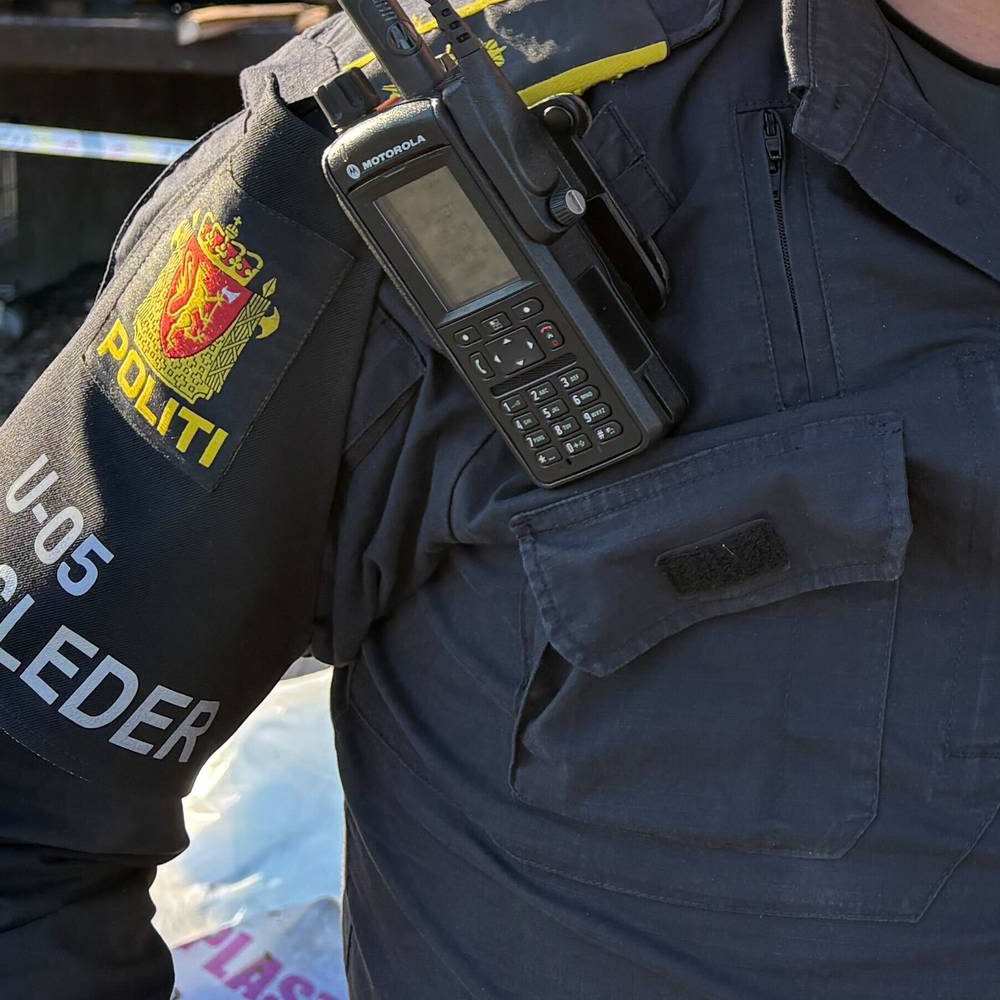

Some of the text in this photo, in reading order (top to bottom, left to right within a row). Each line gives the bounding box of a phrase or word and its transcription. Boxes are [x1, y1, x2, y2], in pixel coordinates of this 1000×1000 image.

[362, 134, 427, 170] MOTOROLA
[560, 377, 569, 388] 3
[97, 318, 229, 468] POLITI
[530, 390, 540, 401] 2
[572, 394, 581, 405] 6
[542, 408, 552, 418] 5
[583, 412, 592, 423] 9
[554, 425, 563, 435] 8
[5, 453, 115, 597] U-05
[172, 922, 340, 1000] LAS
